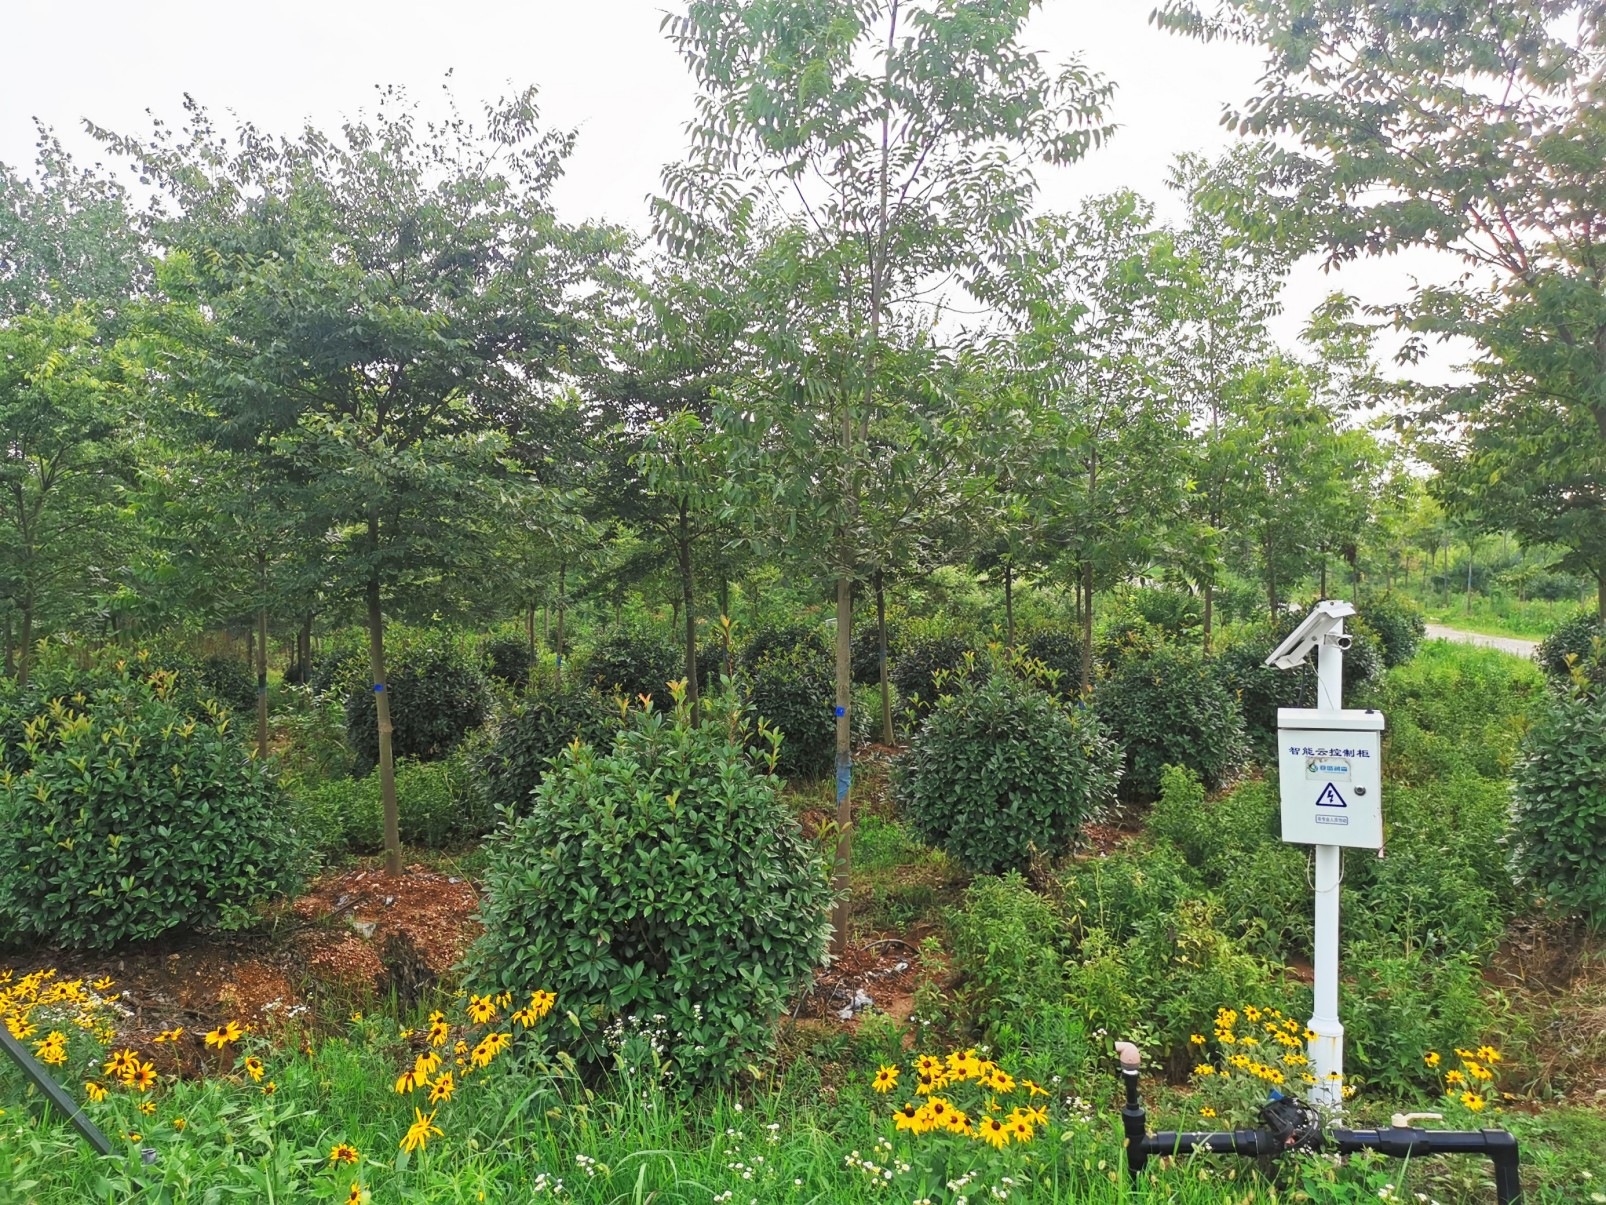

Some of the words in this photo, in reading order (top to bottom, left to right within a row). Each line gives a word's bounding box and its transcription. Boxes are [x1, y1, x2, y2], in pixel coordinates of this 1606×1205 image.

[1288, 746, 1370, 758] 智能云控制柜
